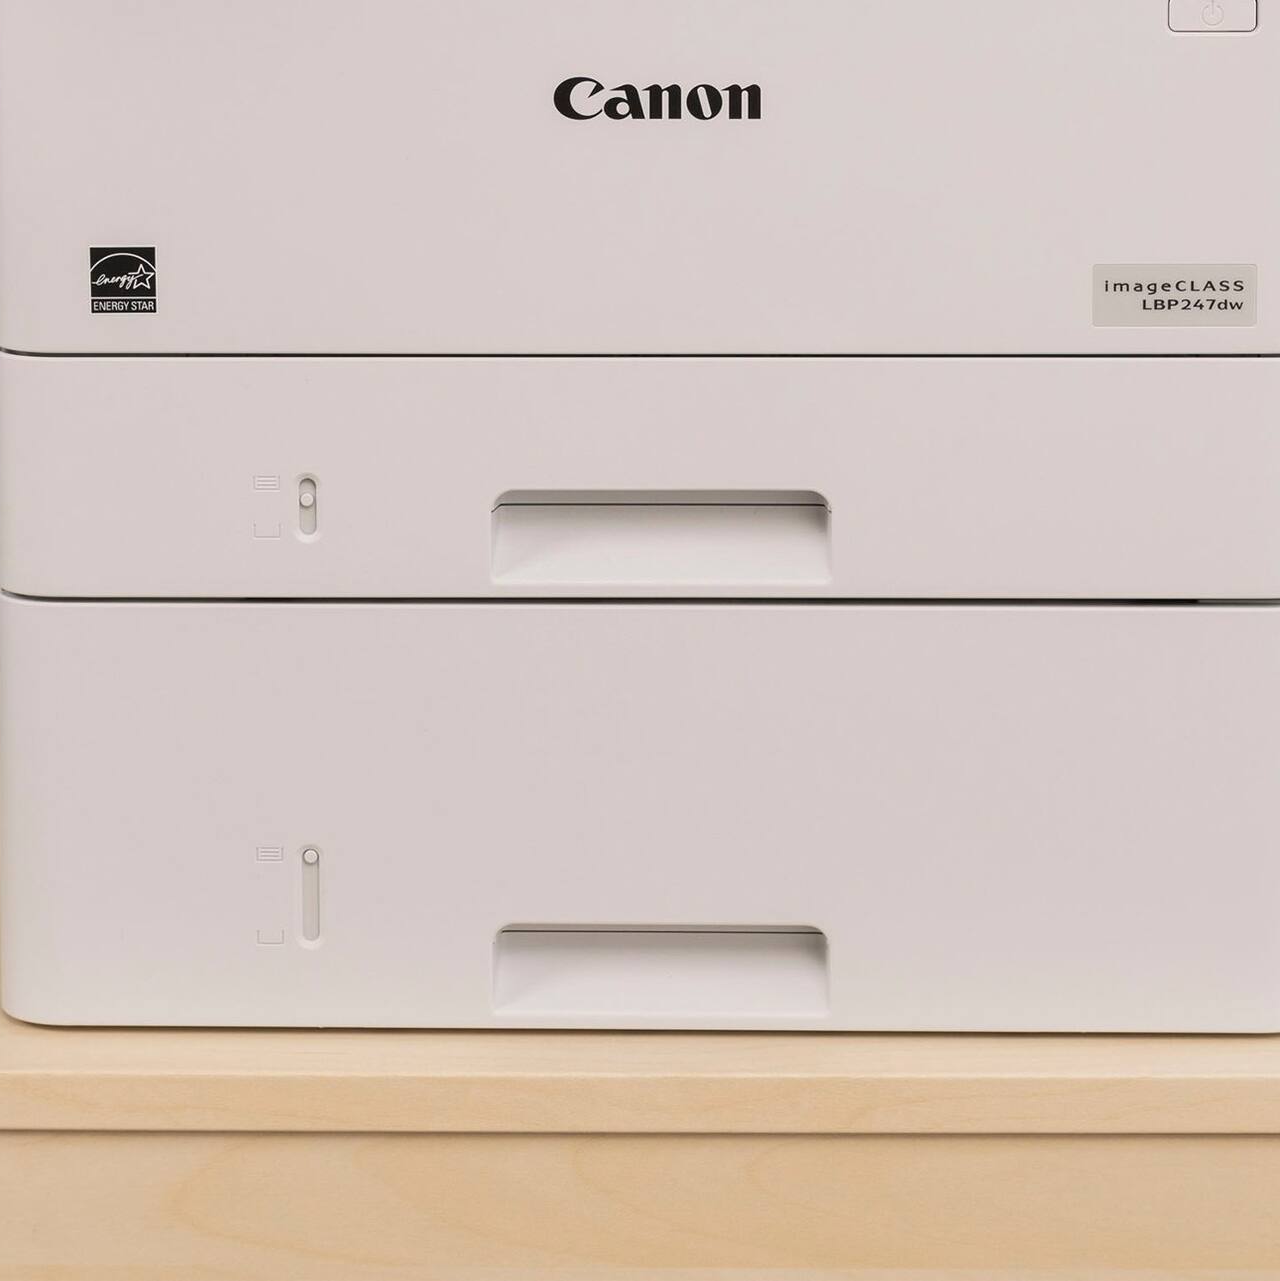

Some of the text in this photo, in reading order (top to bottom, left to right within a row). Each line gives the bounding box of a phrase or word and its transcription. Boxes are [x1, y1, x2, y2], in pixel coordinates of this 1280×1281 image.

[553, 76, 762, 121] Canon
[92, 273, 144, 290] energy
[1104, 280, 1245, 296] imageCLASS
[93, 301, 155, 312] ENERGY STAR
[1142, 299, 1244, 311] LBP247dw
